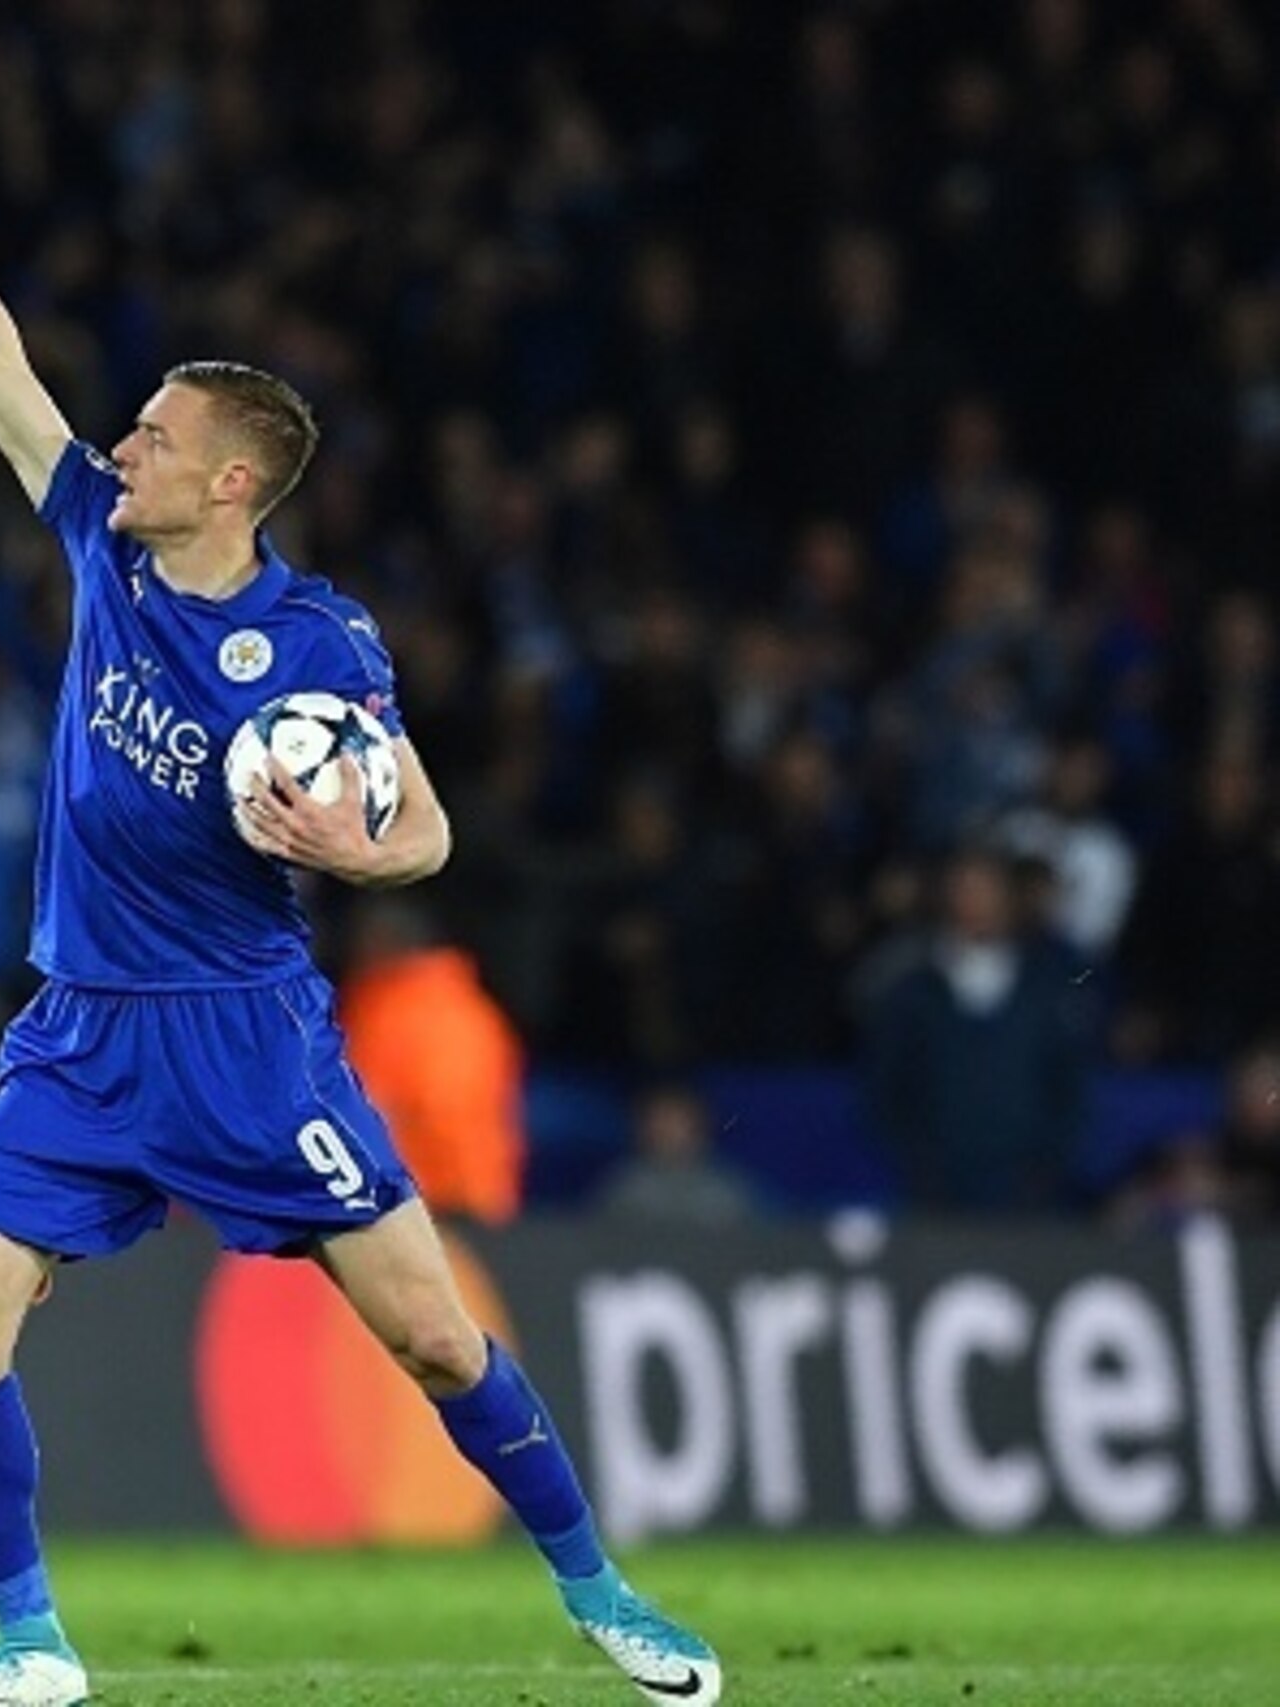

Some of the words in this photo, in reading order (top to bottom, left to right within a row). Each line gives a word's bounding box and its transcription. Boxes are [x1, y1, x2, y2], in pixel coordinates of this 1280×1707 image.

[89, 706, 200, 800] POWER
[96, 663, 209, 765] KING
[297, 1119, 363, 1198] 9
[578, 1206, 1280, 1545] pricel
